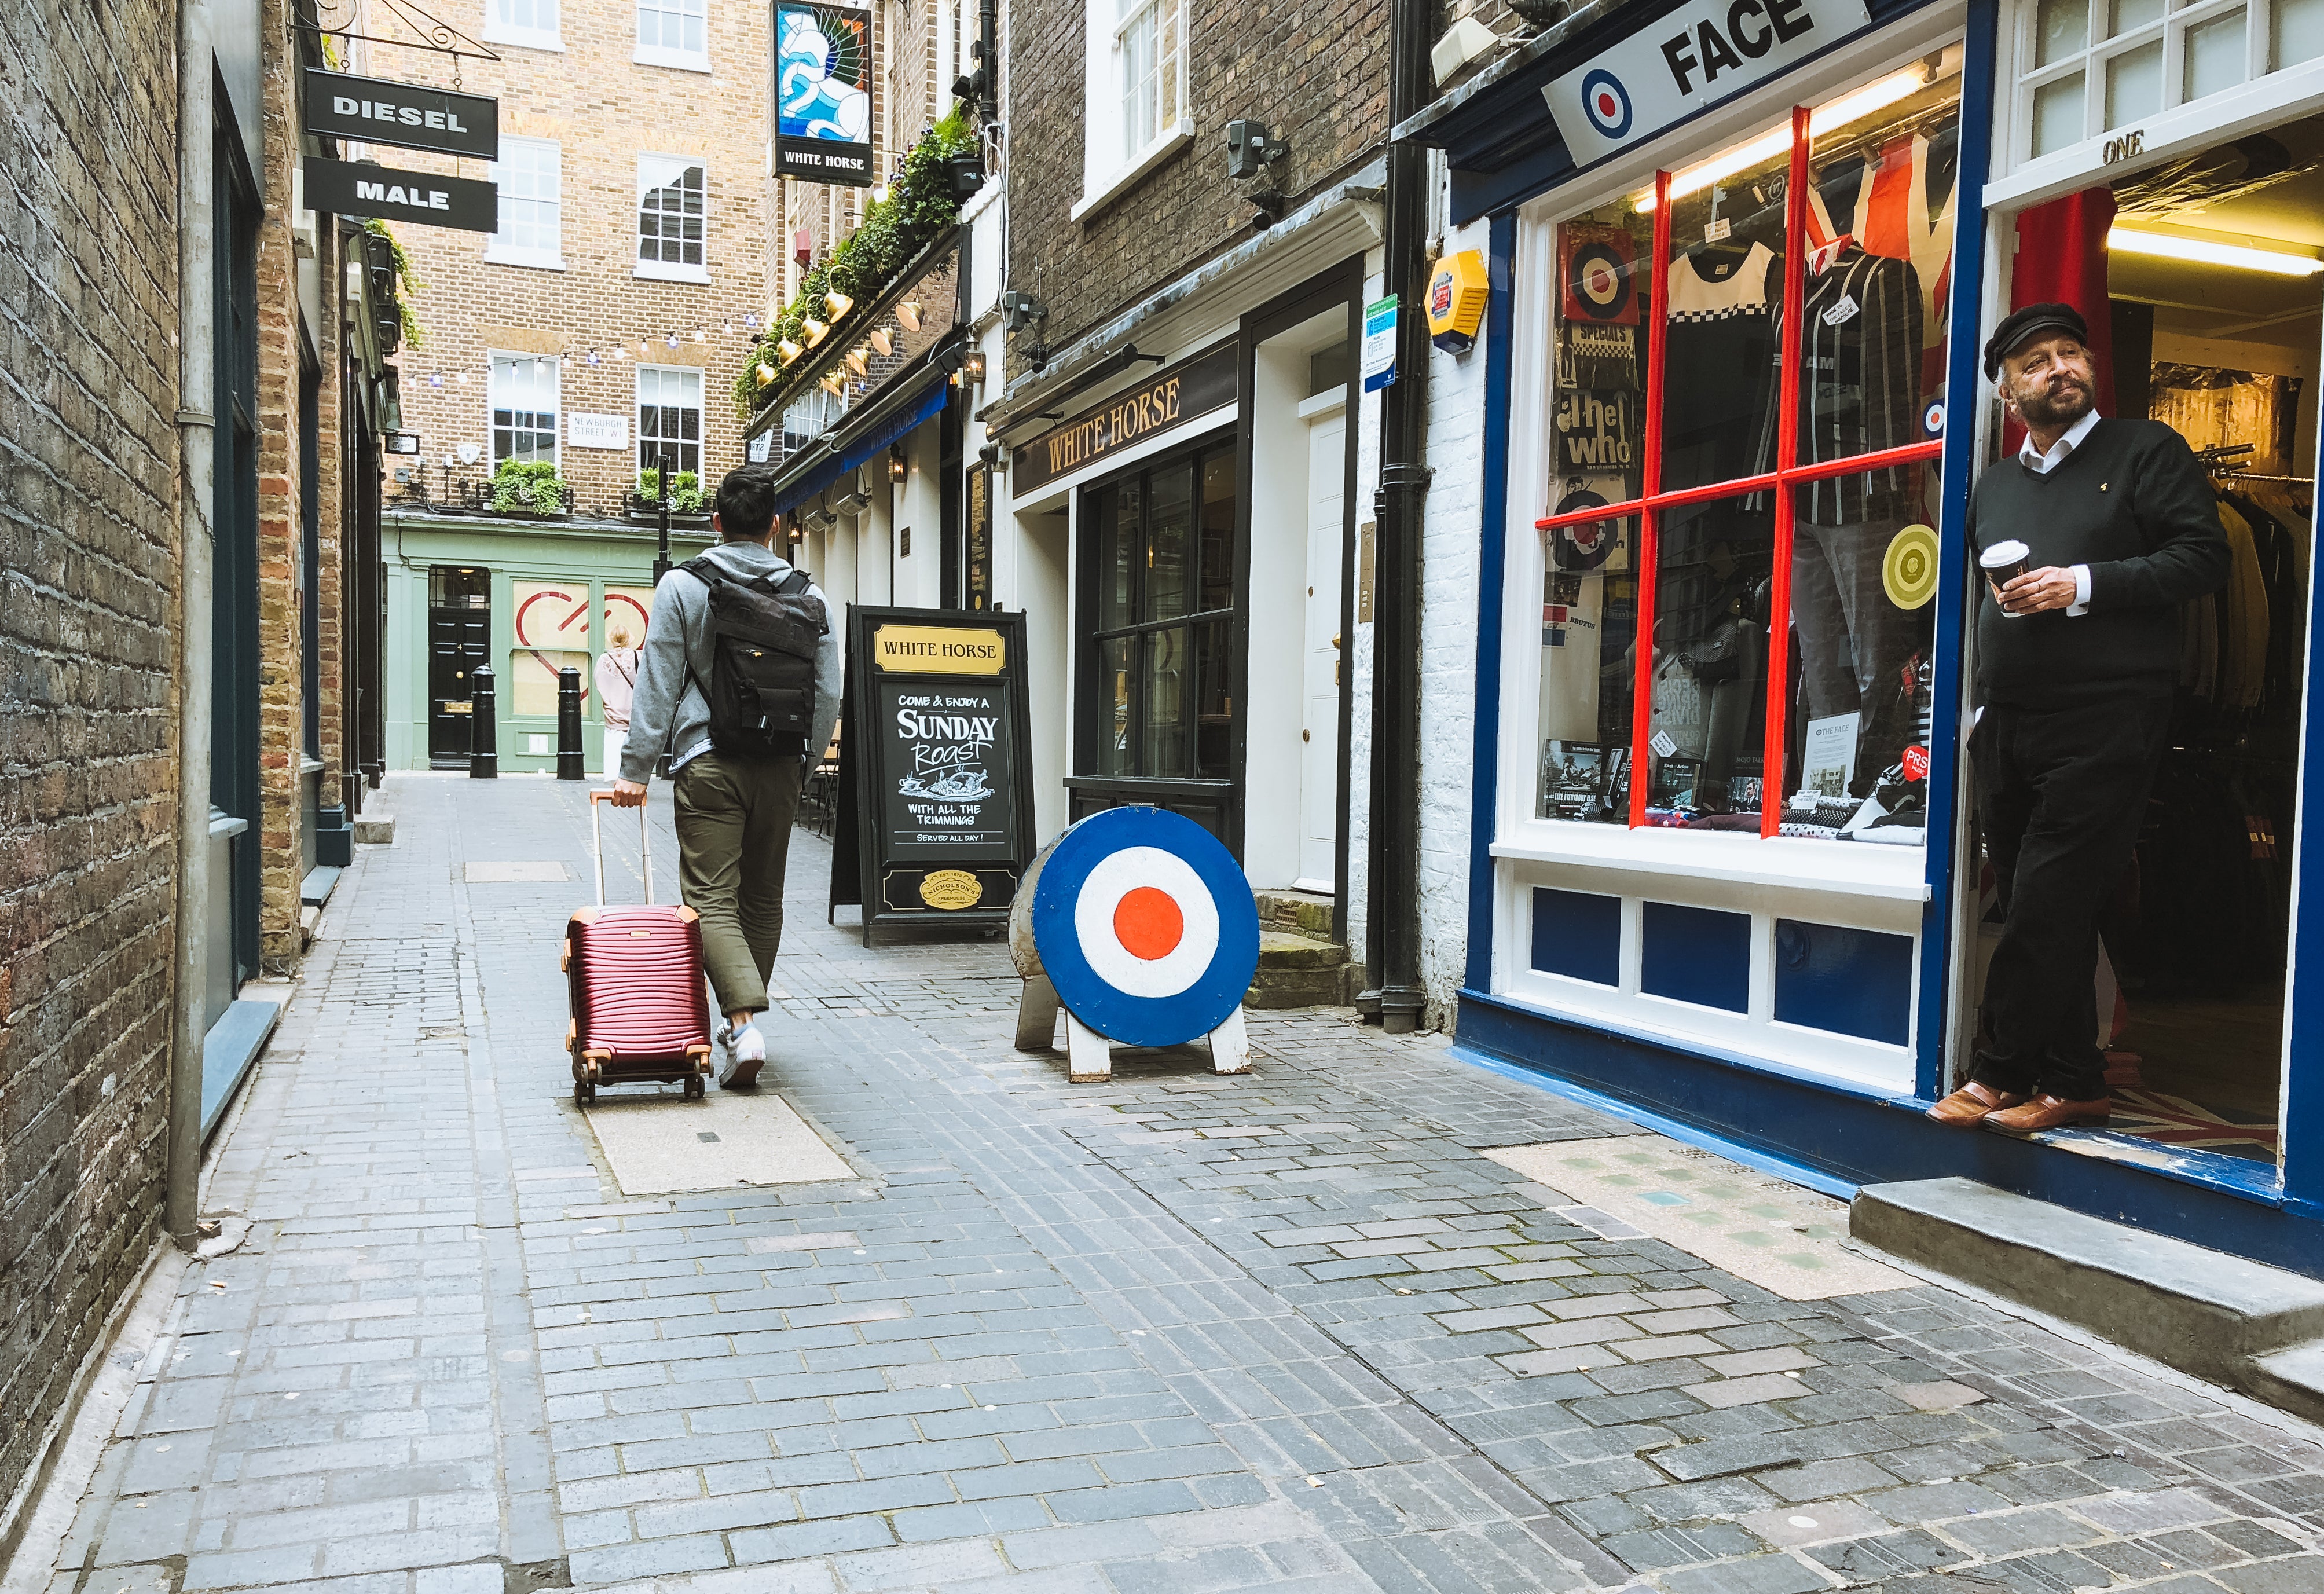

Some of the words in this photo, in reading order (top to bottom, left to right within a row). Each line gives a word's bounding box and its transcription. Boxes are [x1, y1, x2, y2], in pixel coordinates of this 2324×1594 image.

[1660, 0, 1815, 96] FACE
[333, 96, 467, 133] DIESEL
[2103, 129, 2144, 165] ONE
[785, 151, 822, 166] WHITE
[825, 156, 864, 170] HORSE
[357, 180, 449, 211] MALE
[1581, 323, 1626, 342] SPECIALS
[575, 417, 621, 428] NEWBURGH
[575, 427, 604, 436] STREET
[869, 423, 893, 450] WHITE
[893, 401, 918, 436] HORSE
[1048, 414, 1105, 474] WHITE
[1109, 376, 1180, 447] HORSE
[1570, 617, 1596, 629] BRUTUS
[884, 641, 937, 657] WHITE
[942, 643, 996, 659] HORSE
[898, 695, 930, 706] COME
[933, 695, 943, 707] &
[945, 697, 978, 708] ENJOY
[981, 698, 989, 708] A
[897, 709, 999, 741] SUNDAY
[1822, 727, 1834, 735] THE
[1834, 724, 1849, 734] FACE
[1907, 750, 1928, 769] PRS
[1555, 793, 1563, 801] LIKE
[1564, 793, 1586, 802] EVERYBODY
[908, 804, 934, 814] WITH
[938, 804, 957, 814] ALL
[960, 805, 981, 814] THE
[917, 815, 974, 825] TRIMMINGS
[917, 834, 948, 842] SERVED
[928, 883, 976, 896] NICHOLSON'S
